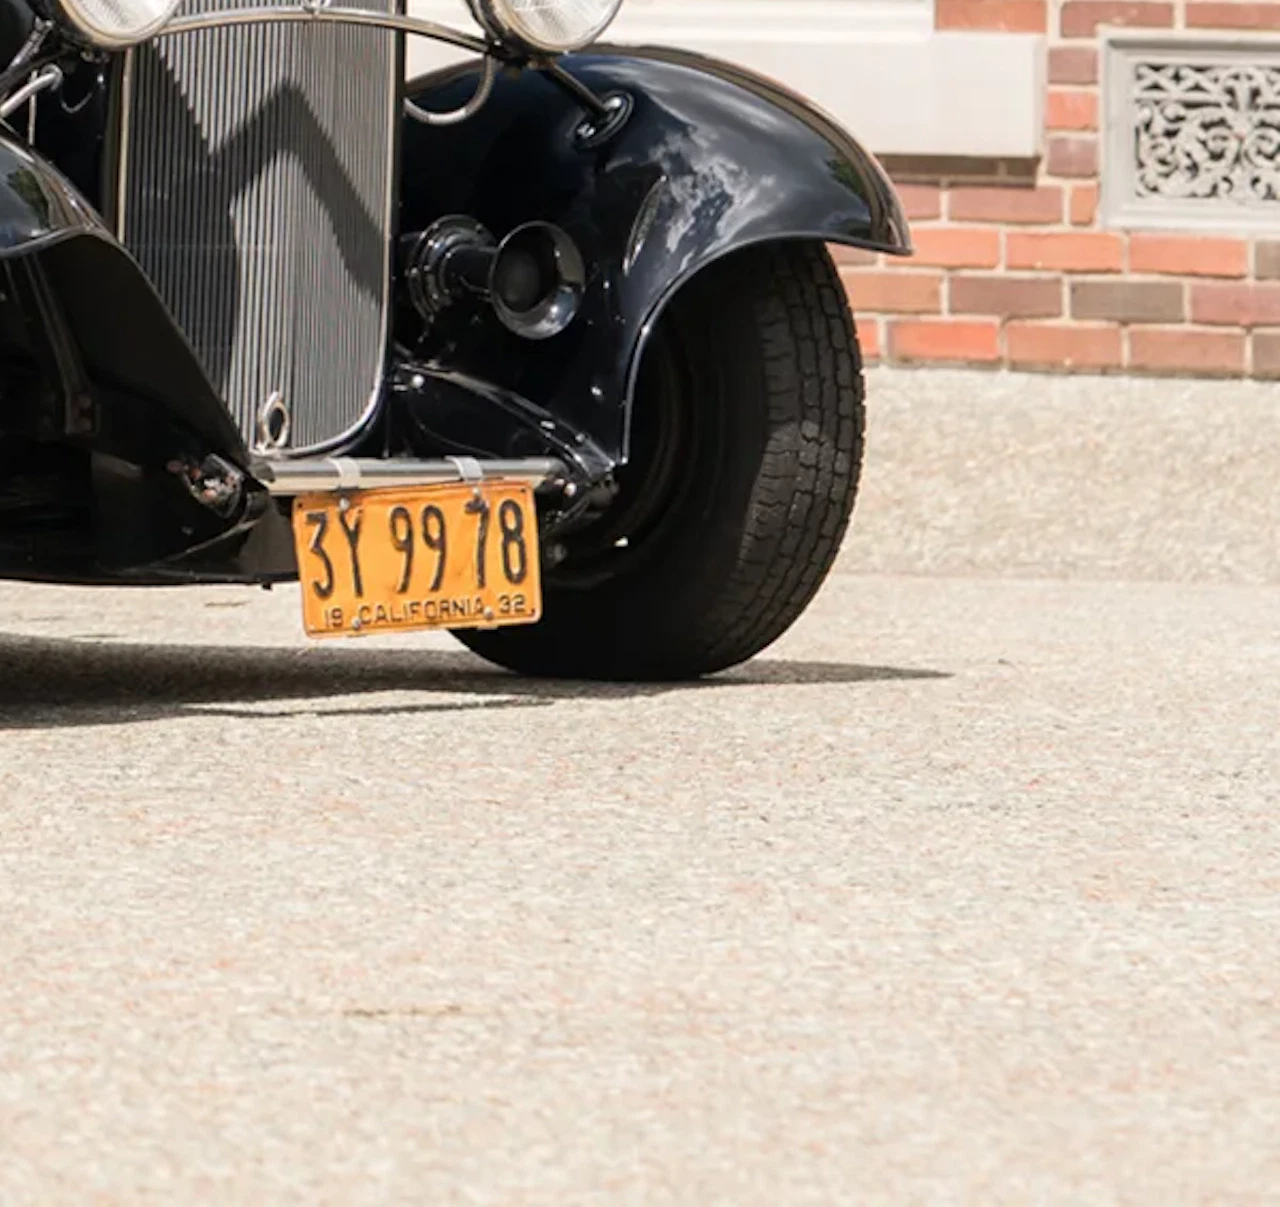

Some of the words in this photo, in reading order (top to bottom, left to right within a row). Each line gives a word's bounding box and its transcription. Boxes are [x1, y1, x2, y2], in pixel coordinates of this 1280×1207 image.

[306, 508, 364, 598] 3Y
[389, 505, 447, 594] 99
[464, 498, 527, 590] 78
[323, 606, 344, 628] 19
[358, 597, 485, 626] CALIFORNIA
[497, 593, 527, 614] 32
